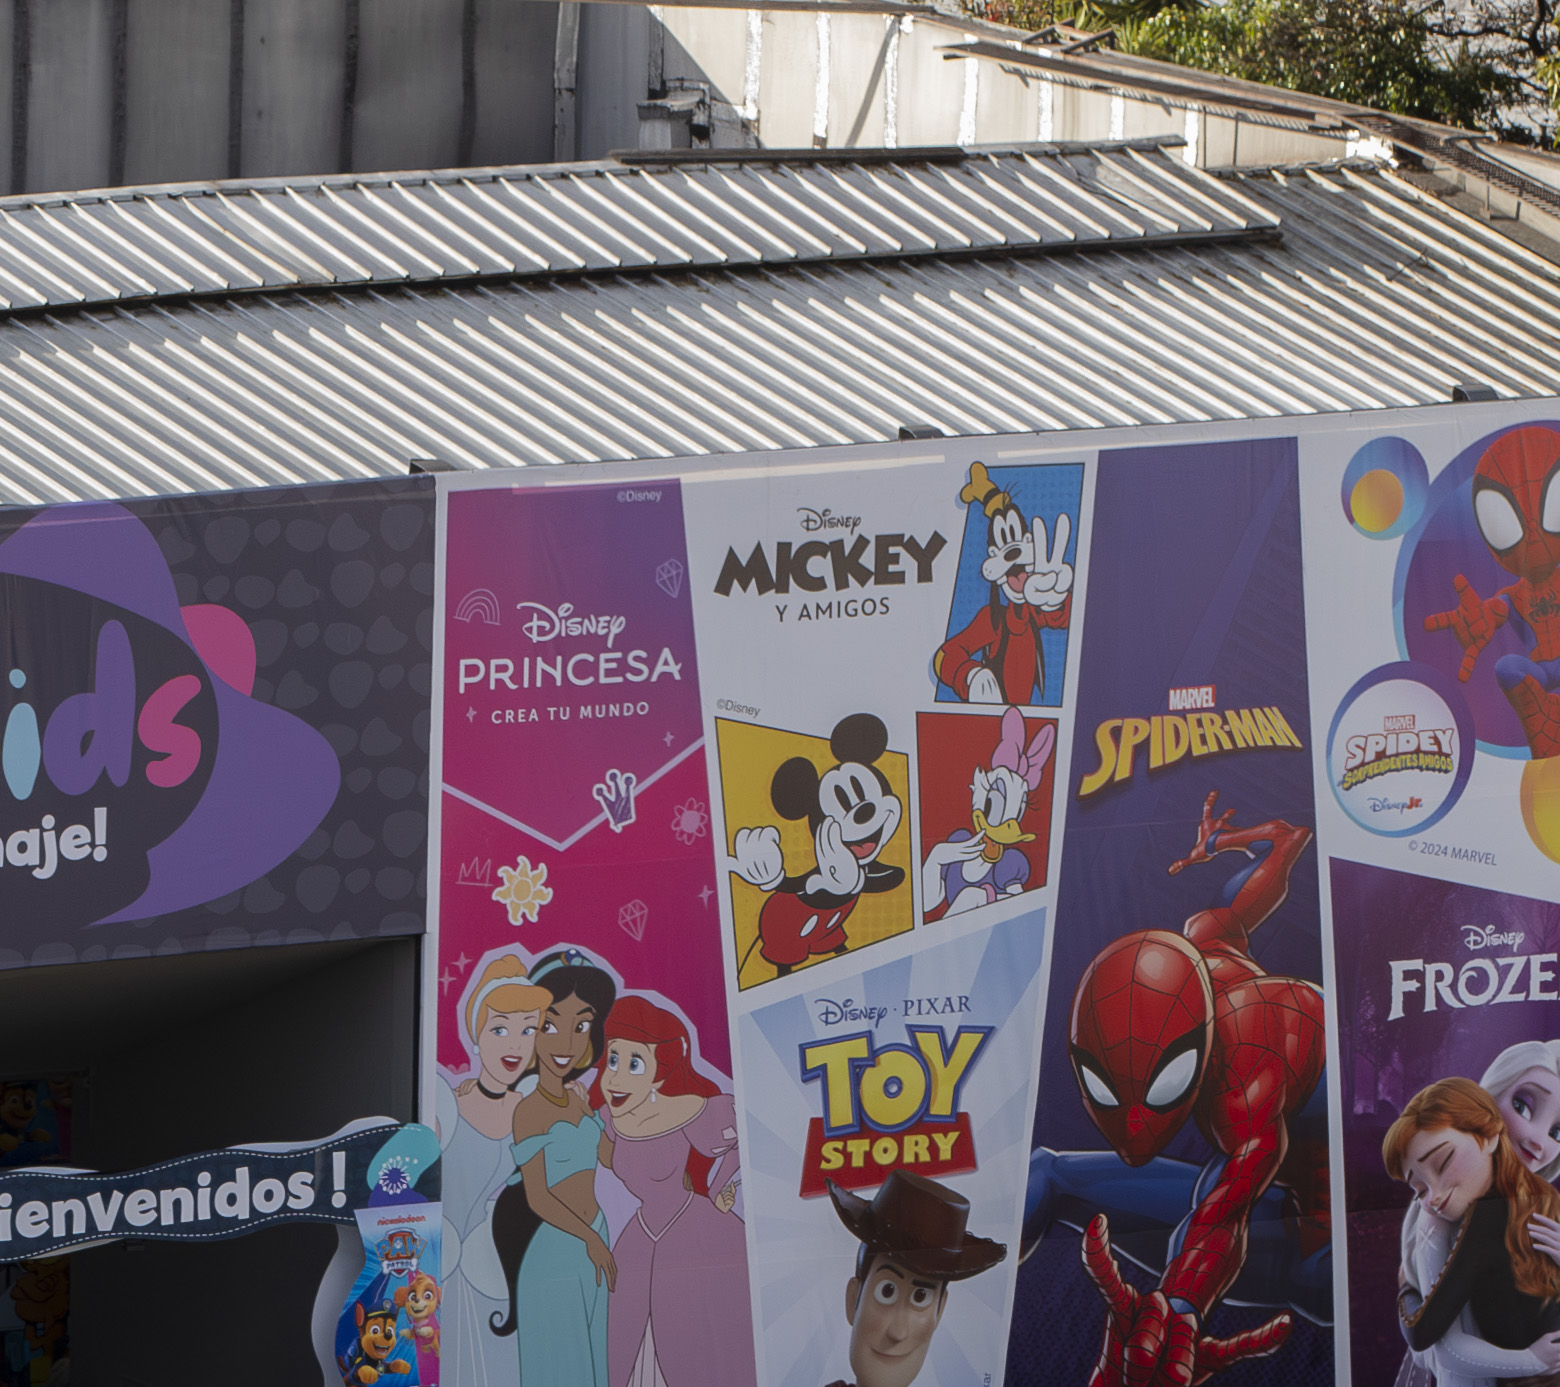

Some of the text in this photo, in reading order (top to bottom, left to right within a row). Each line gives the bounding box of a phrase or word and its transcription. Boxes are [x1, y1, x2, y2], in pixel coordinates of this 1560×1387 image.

[797, 507, 862, 536] Disney
[713, 530, 948, 597] MICKEY
[517, 602, 626, 647] Disney
[776, 597, 890, 622] Y AMIGOS
[458, 647, 682, 694] PRINCESA
[491, 702, 650, 724] CREA TU MUNDO
[1169, 685, 1216, 710] MARVEL
[1080, 706, 1303, 797] SPIDER-MAN
[1345, 728, 1454, 771] SPIDEY
[1451, 845, 1497, 867] MARVEL
[1460, 924, 1524, 952] Disney
[813, 995, 972, 1028] Disney PIXAR
[799, 1024, 995, 1139] TOY
[820, 1131, 960, 1171] STORY
